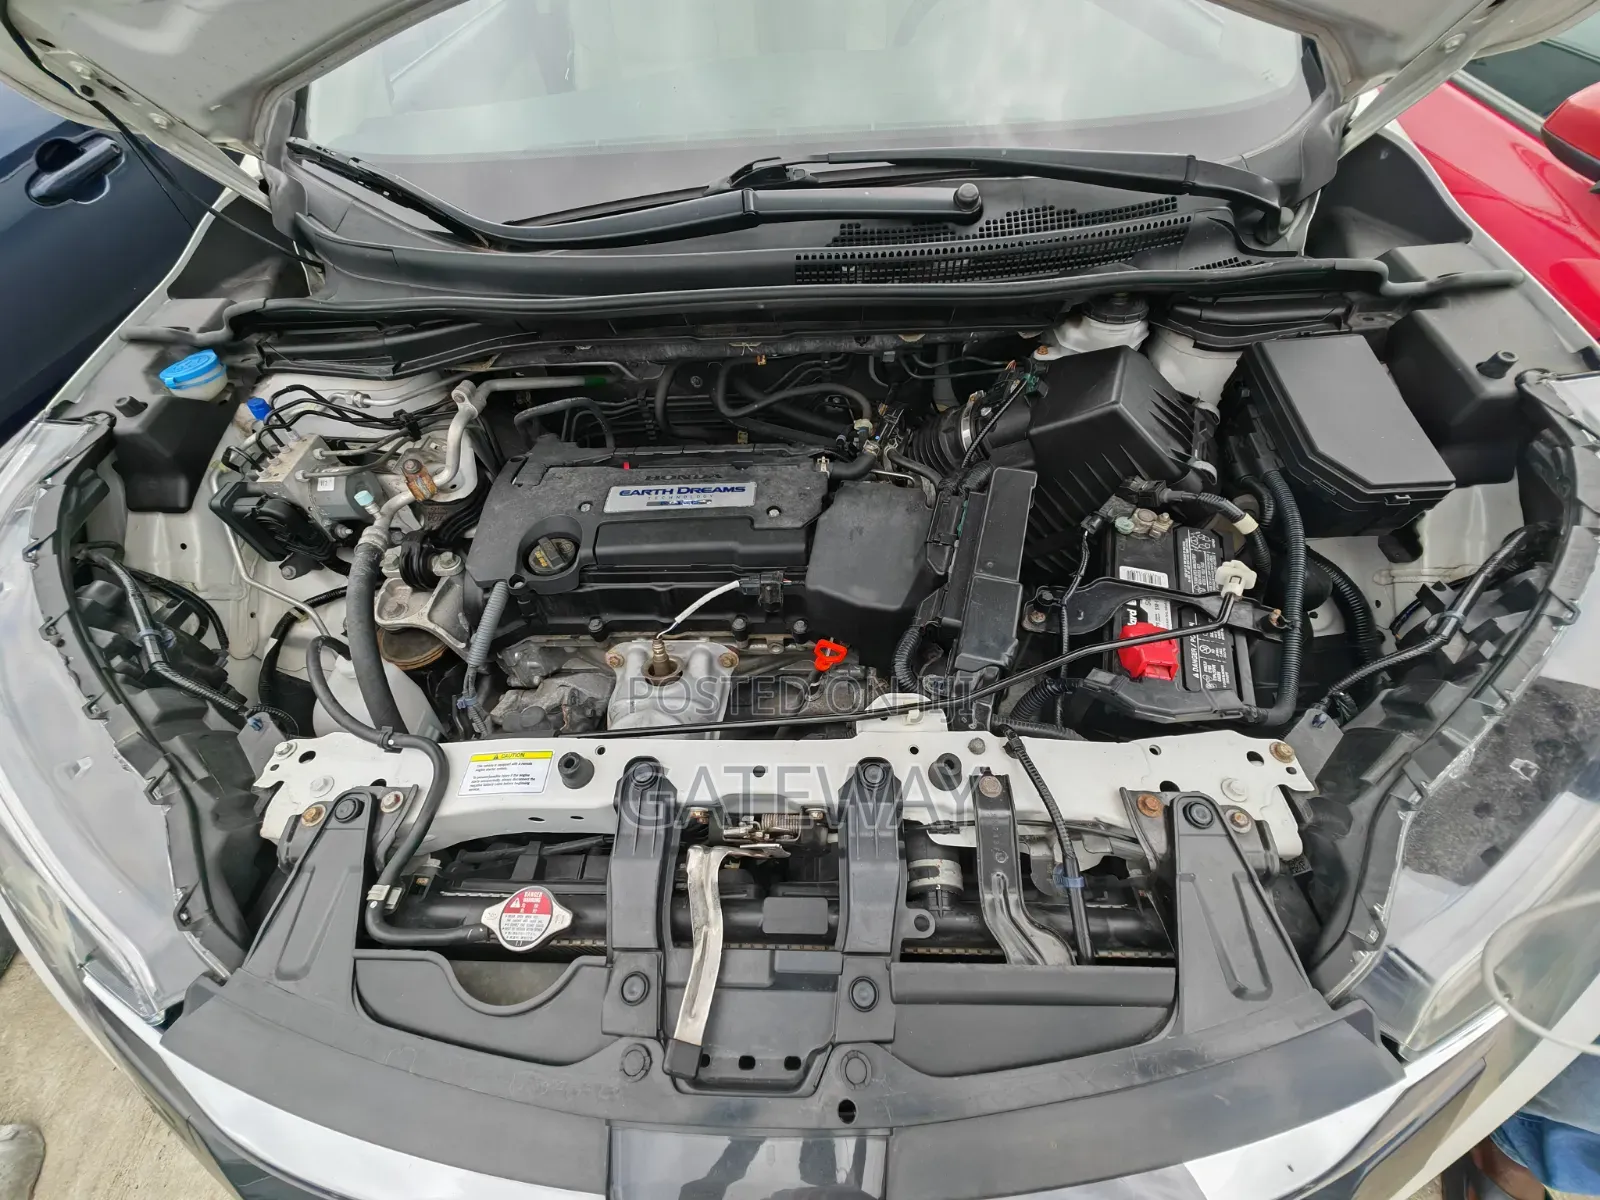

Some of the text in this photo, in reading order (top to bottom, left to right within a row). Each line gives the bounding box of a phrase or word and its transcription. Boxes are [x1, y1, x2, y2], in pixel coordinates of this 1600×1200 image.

[619, 486, 746, 497] EARTH DREAMS
[1190, 647, 1199, 673] DANGER
